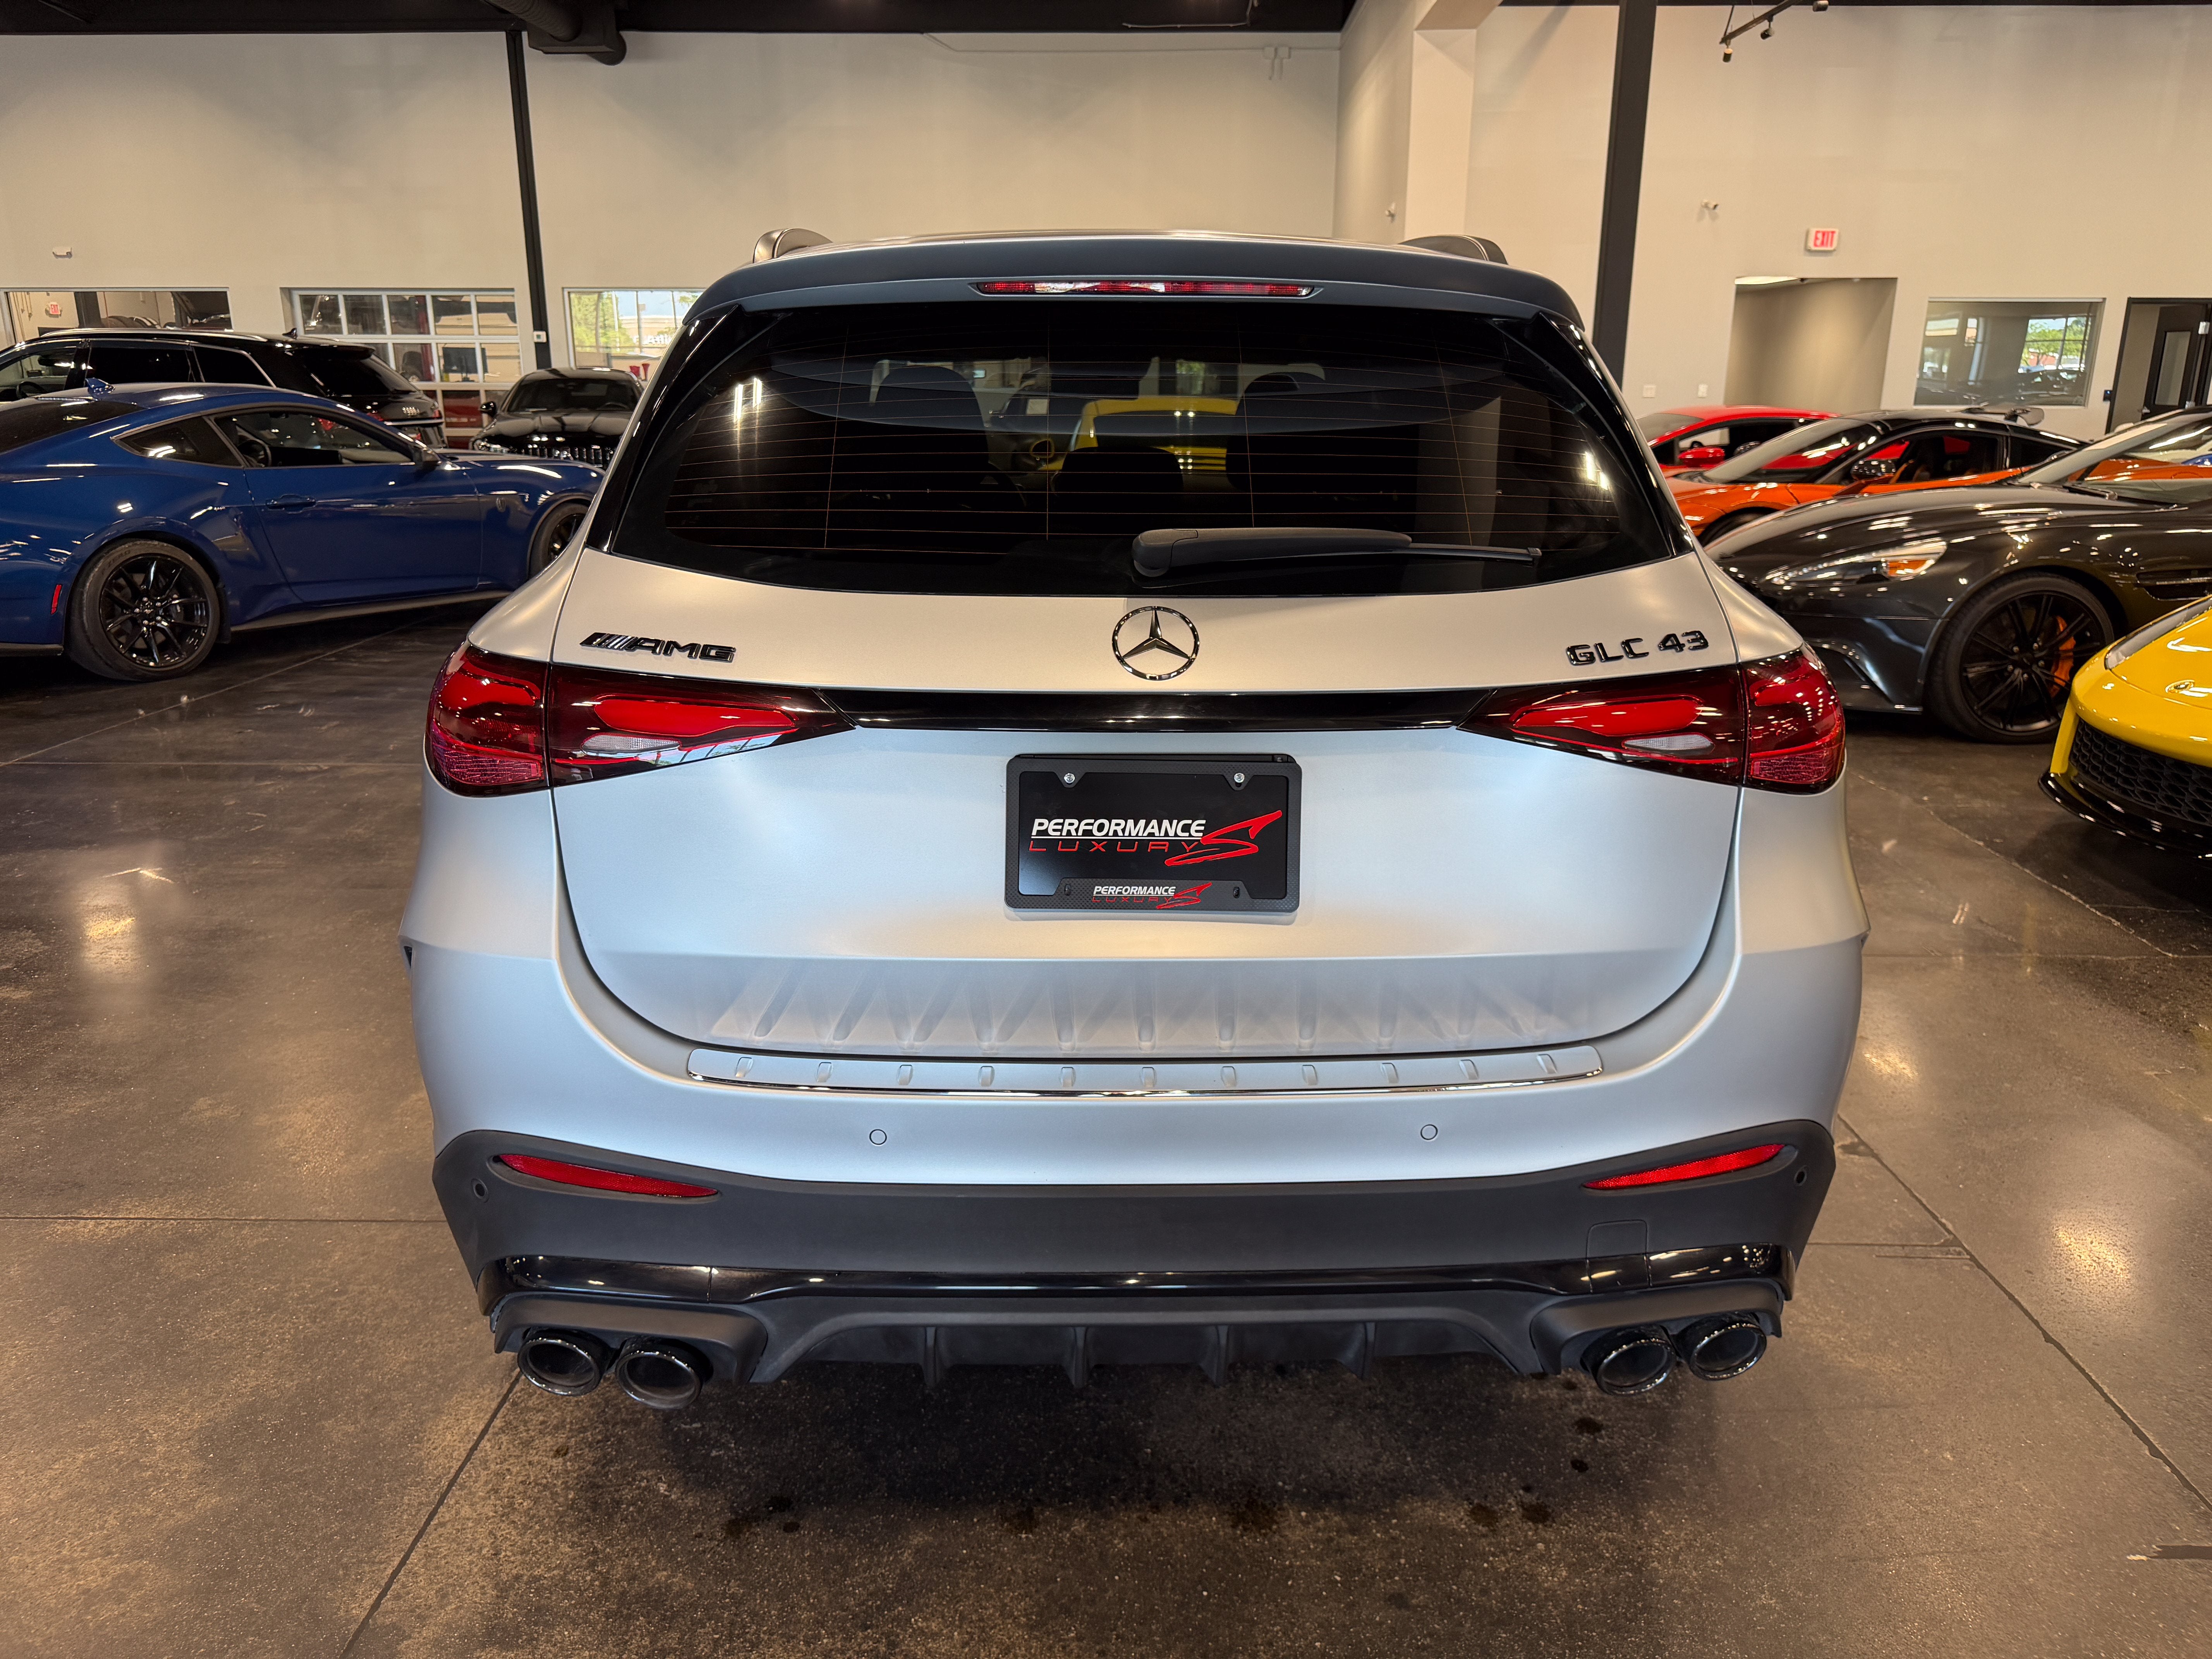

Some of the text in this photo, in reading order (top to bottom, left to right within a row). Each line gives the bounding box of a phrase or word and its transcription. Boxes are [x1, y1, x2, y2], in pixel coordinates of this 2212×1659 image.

[1814, 230, 1836, 247] EXIT
[625, 637, 736, 663] AMG
[1566, 630, 1709, 666] GLC 43
[1031, 818, 1206, 837] PERFORMANCE
[1029, 841, 1200, 852] LUXURY
[1093, 886, 1176, 895] PERFORMANCE
